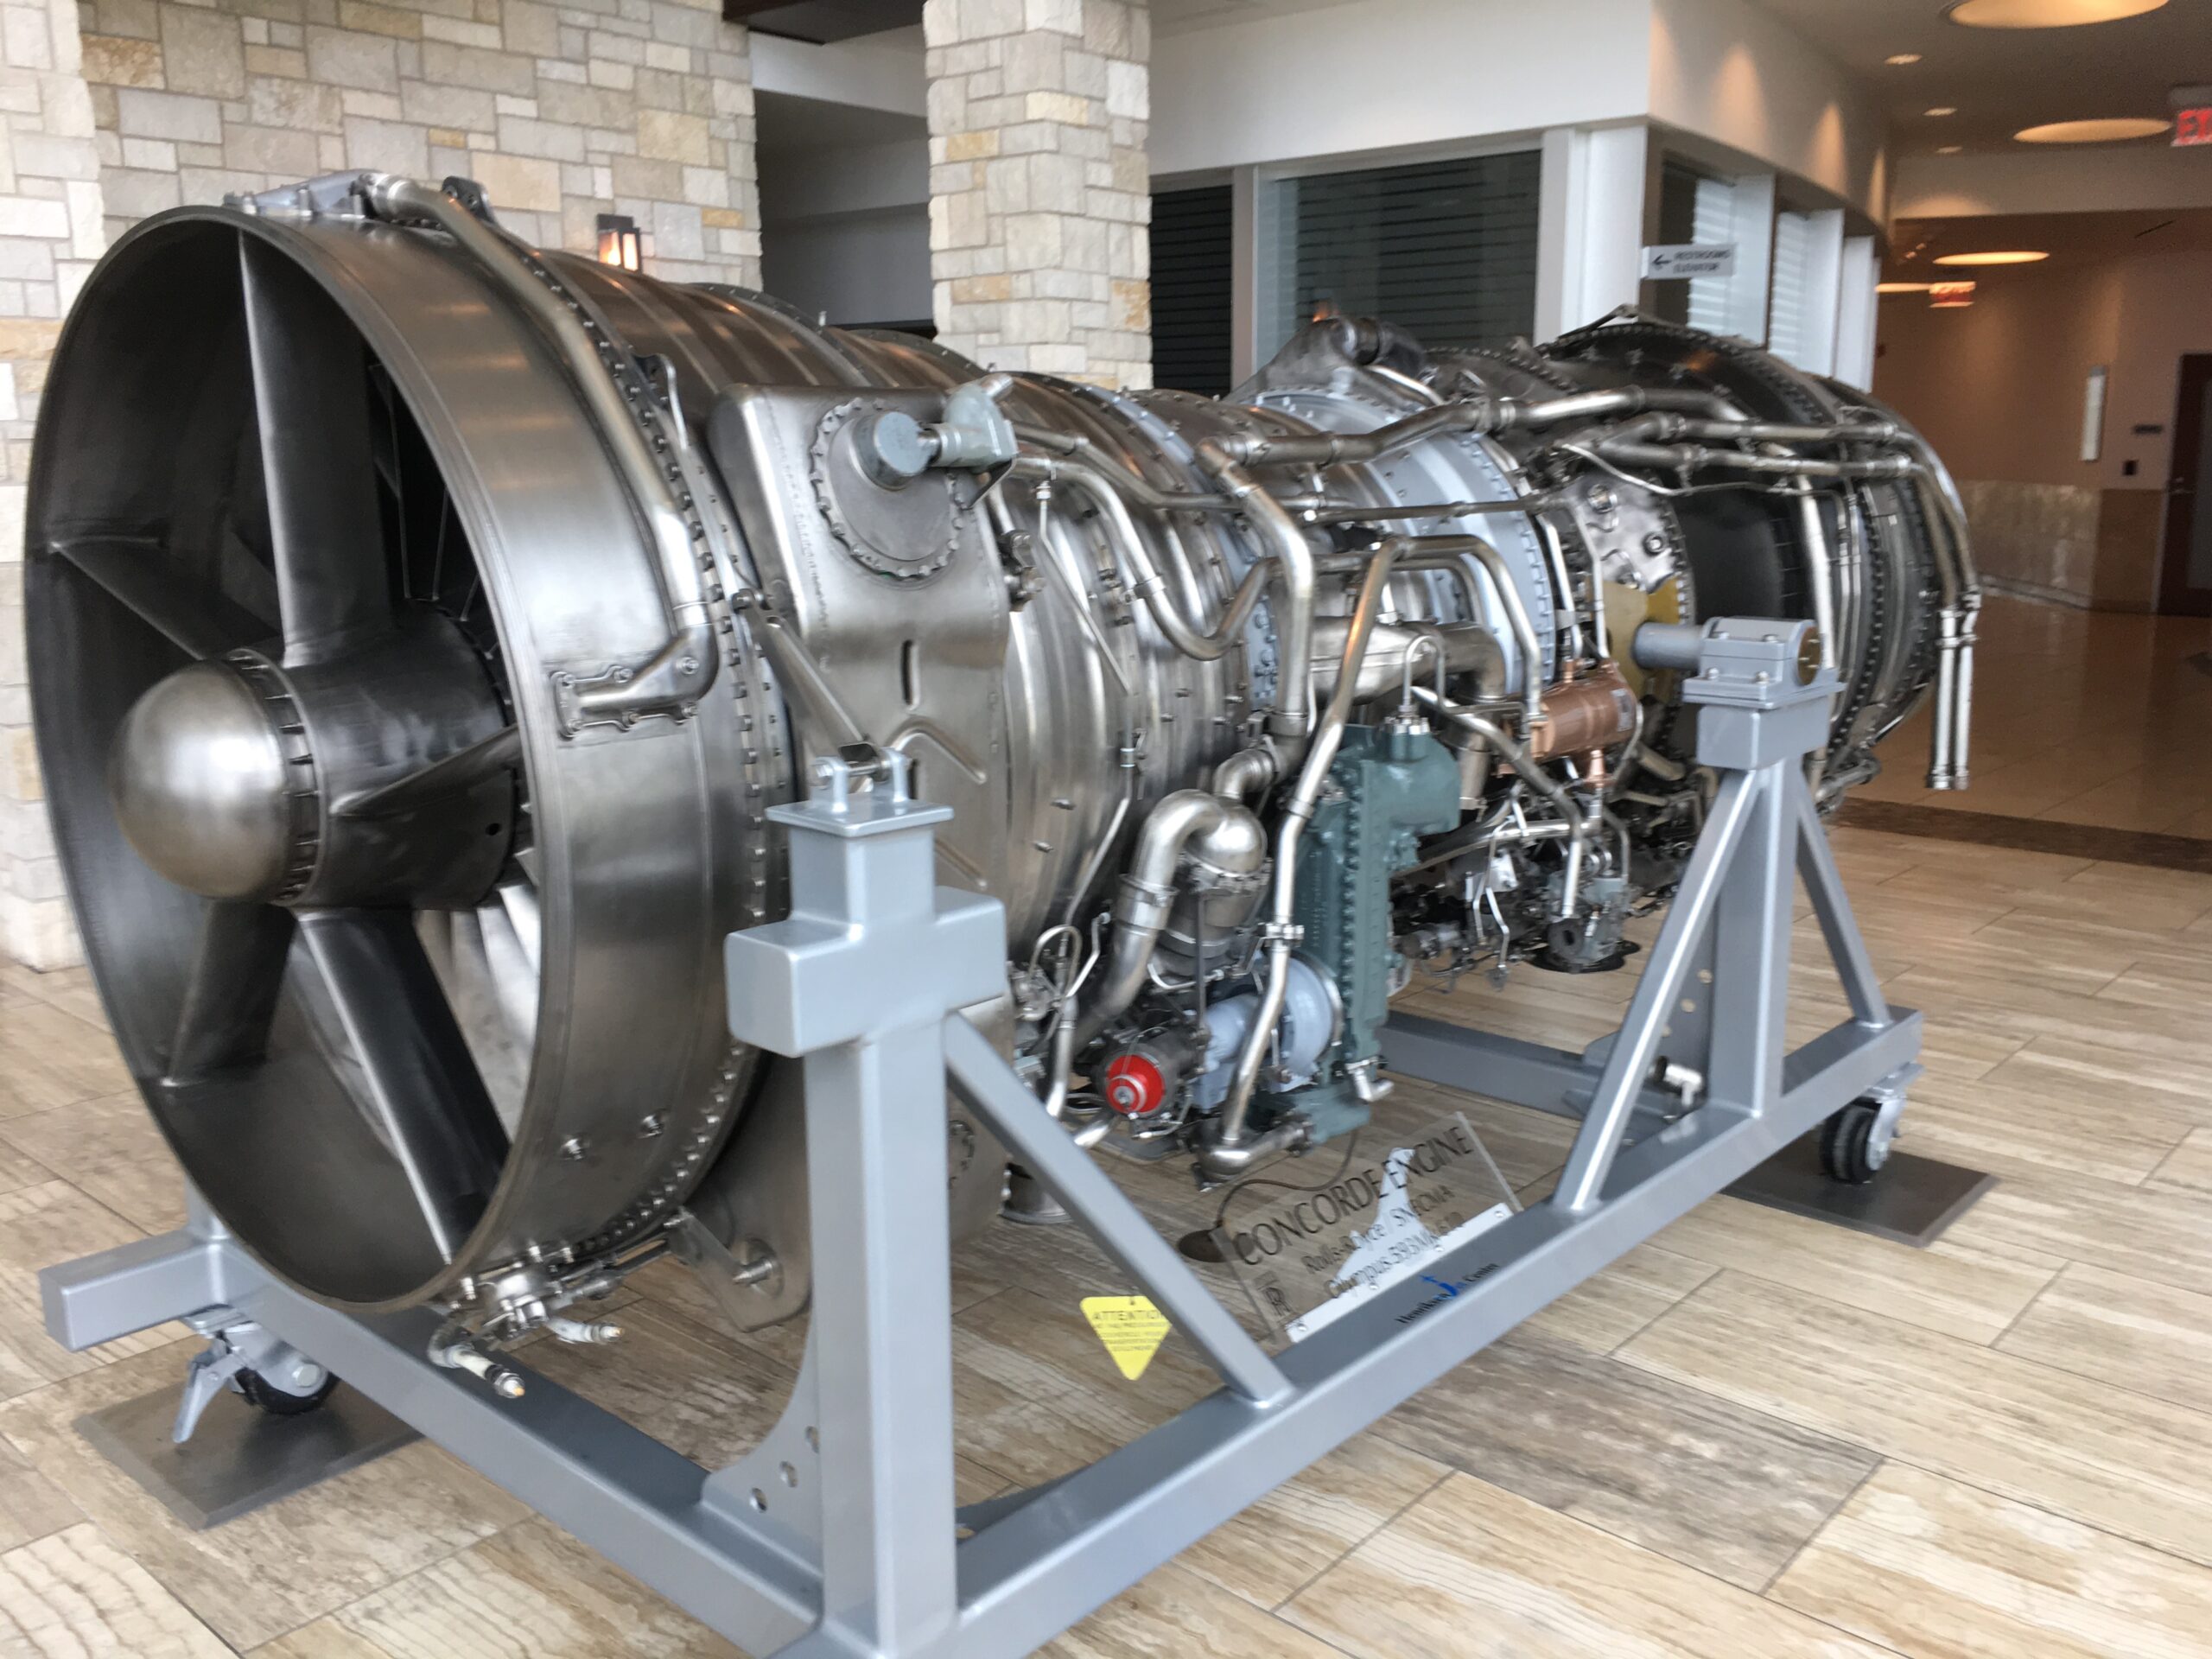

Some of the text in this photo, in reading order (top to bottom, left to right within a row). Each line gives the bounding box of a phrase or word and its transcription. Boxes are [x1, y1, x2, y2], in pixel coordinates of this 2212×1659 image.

[2177, 109, 2212, 143] EX
[1233, 1126, 1475, 1265] CONCORDE ENGINE
